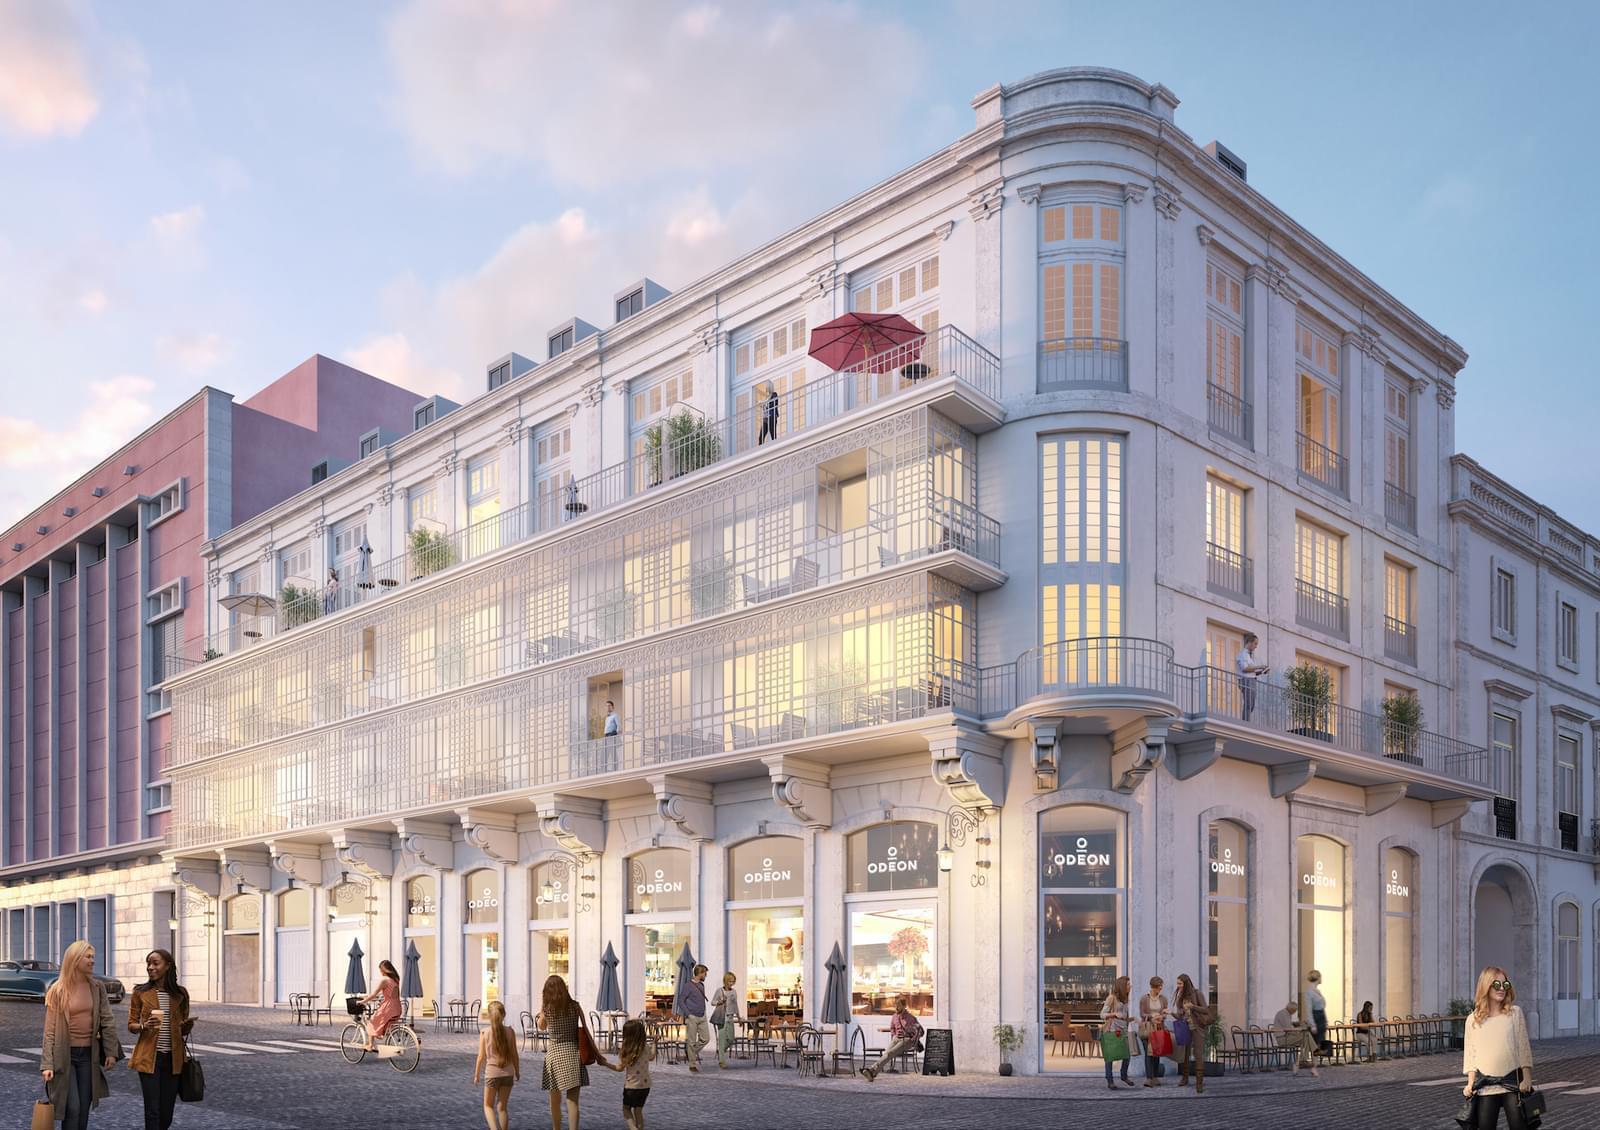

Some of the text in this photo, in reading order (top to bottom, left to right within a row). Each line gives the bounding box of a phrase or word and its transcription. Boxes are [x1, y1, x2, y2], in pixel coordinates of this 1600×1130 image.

[868, 859, 918, 873] ODEON
[1054, 854, 1110, 866] ODEON
[1211, 861, 1245, 876] ODEON
[744, 870, 792, 883] ODEON
[1303, 873, 1337, 888] ODEON
[636, 881, 683, 895] ODEON
[1386, 883, 1409, 897] DEON
[468, 898, 498, 909] ODEO
